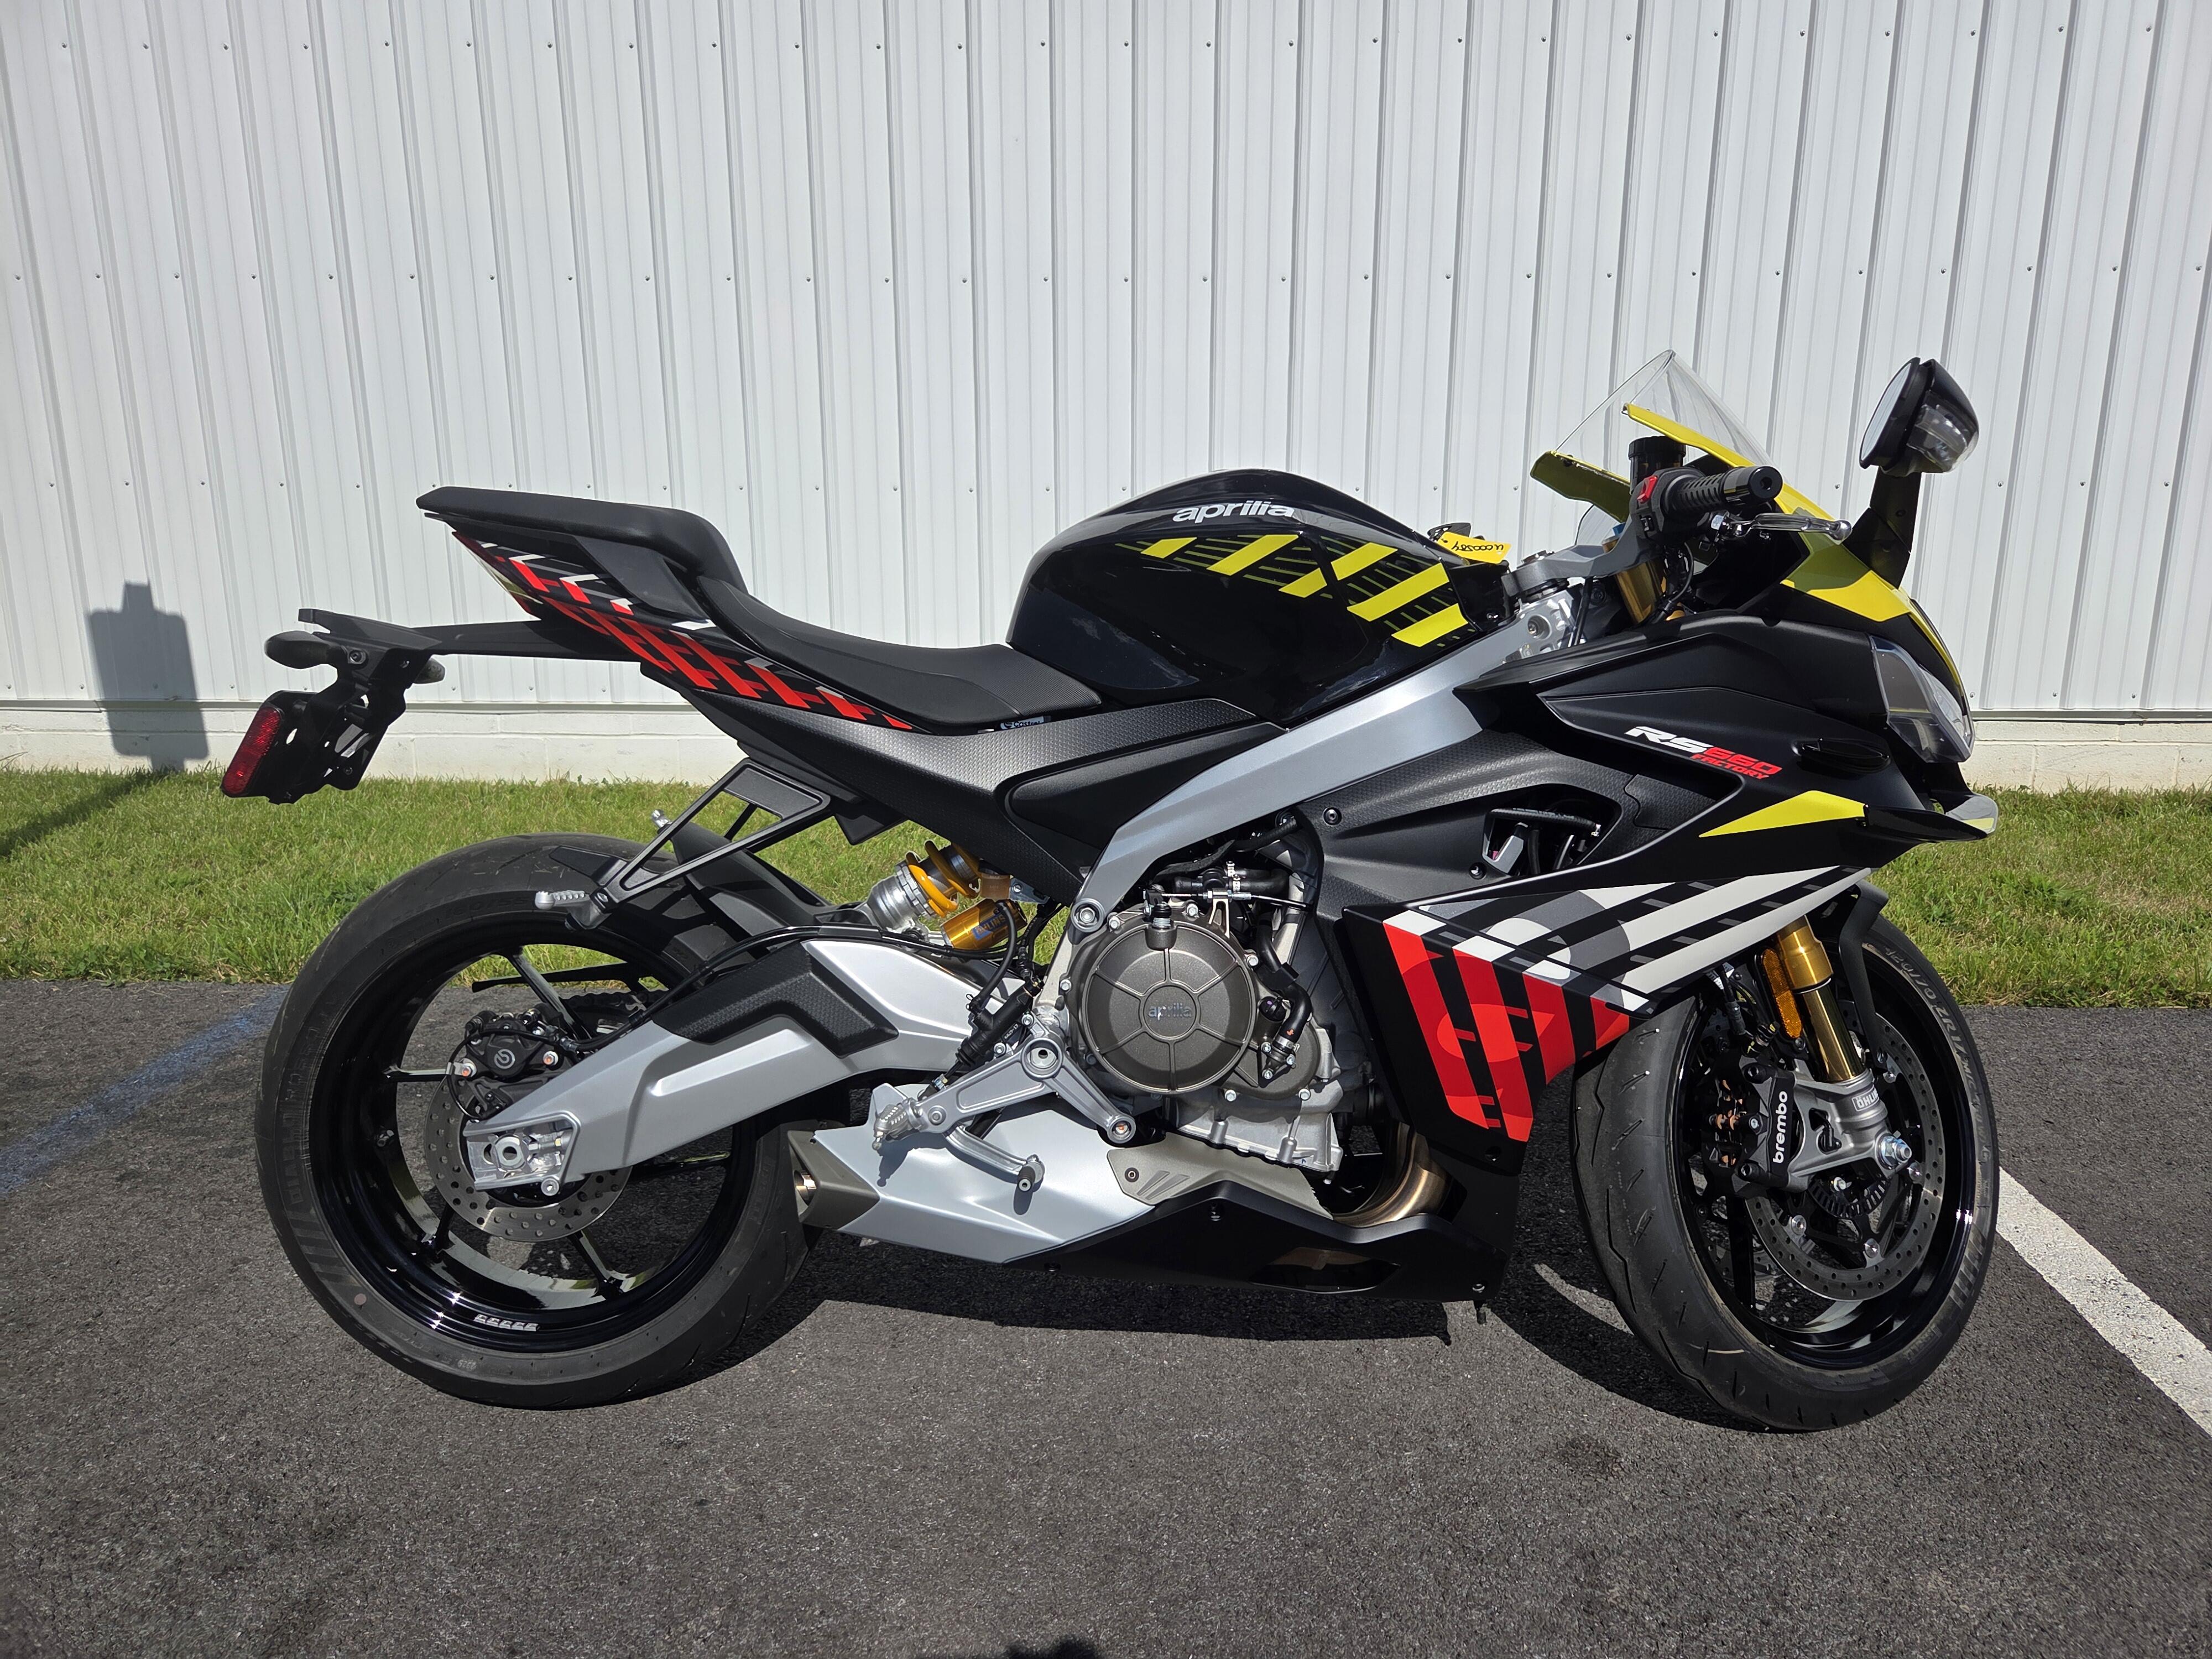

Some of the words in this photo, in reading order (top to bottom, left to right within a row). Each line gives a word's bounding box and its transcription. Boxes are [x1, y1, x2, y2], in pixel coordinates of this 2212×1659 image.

[1172, 500, 1295, 523] aprilia
[1690, 754, 1769, 779] FACTORY
[1148, 1002, 1192, 1021] aprilia
[1855, 1087, 1879, 1108] ÖHLIN
[1772, 1091, 1788, 1164] brembo
